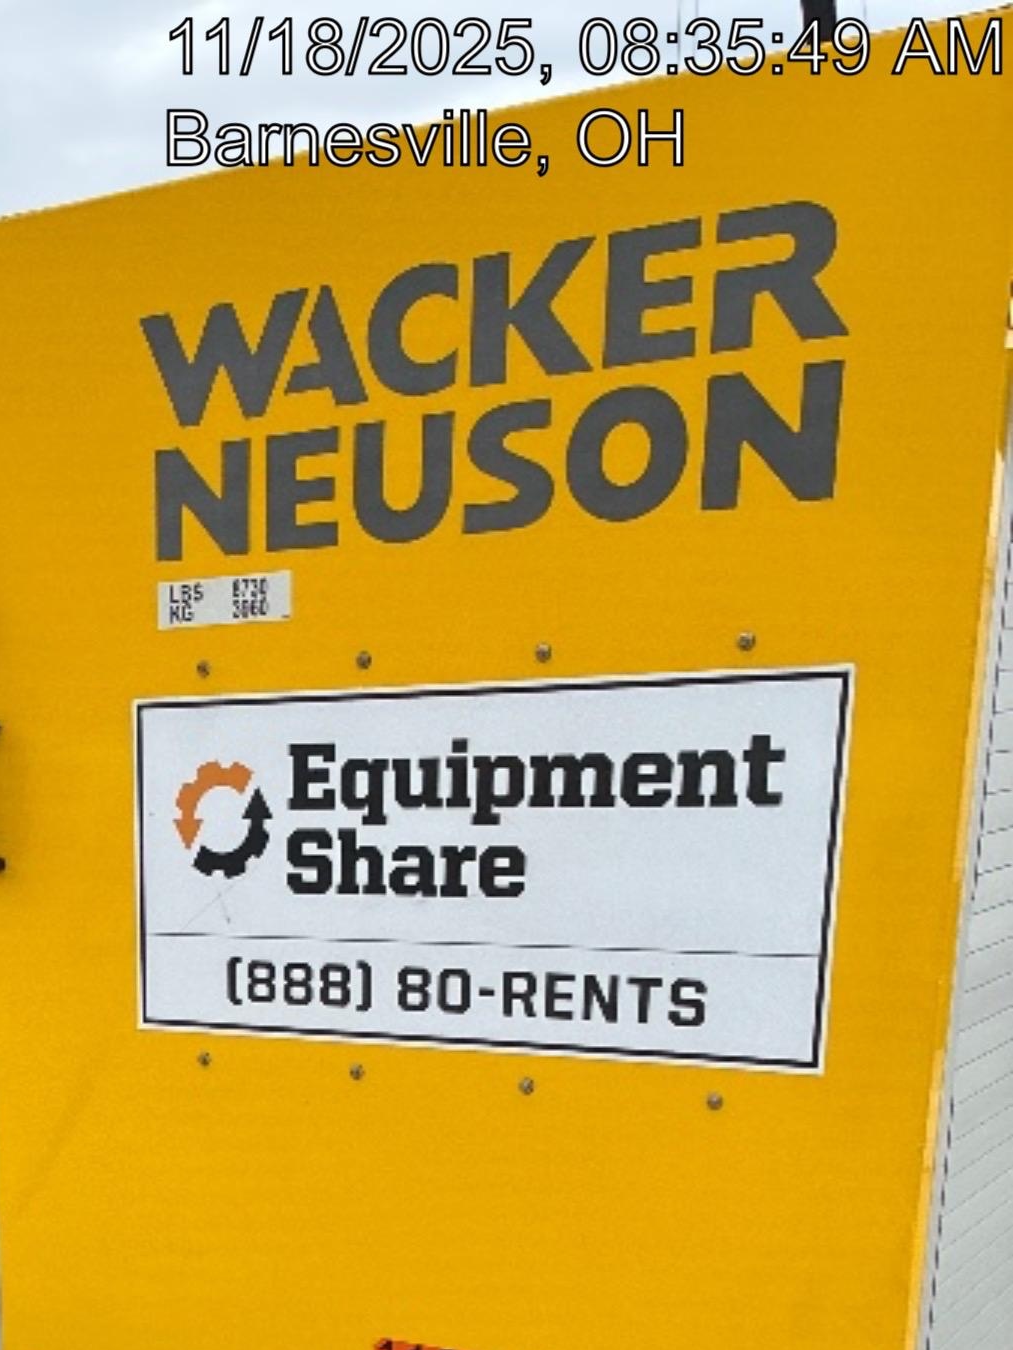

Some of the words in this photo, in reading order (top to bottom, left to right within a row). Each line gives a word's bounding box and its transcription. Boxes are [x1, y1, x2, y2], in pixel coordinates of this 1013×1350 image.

[140, 201, 849, 427] WACKER
[155, 359, 845, 561] NEUSON
[169, 582, 204, 604] LBS
[169, 601, 195, 624] KG
[287, 734, 786, 826] Equipment
[286, 827, 527, 898] Share
[225, 956, 373, 1012] (888)
[396, 964, 709, 1028] 80-RENTS
